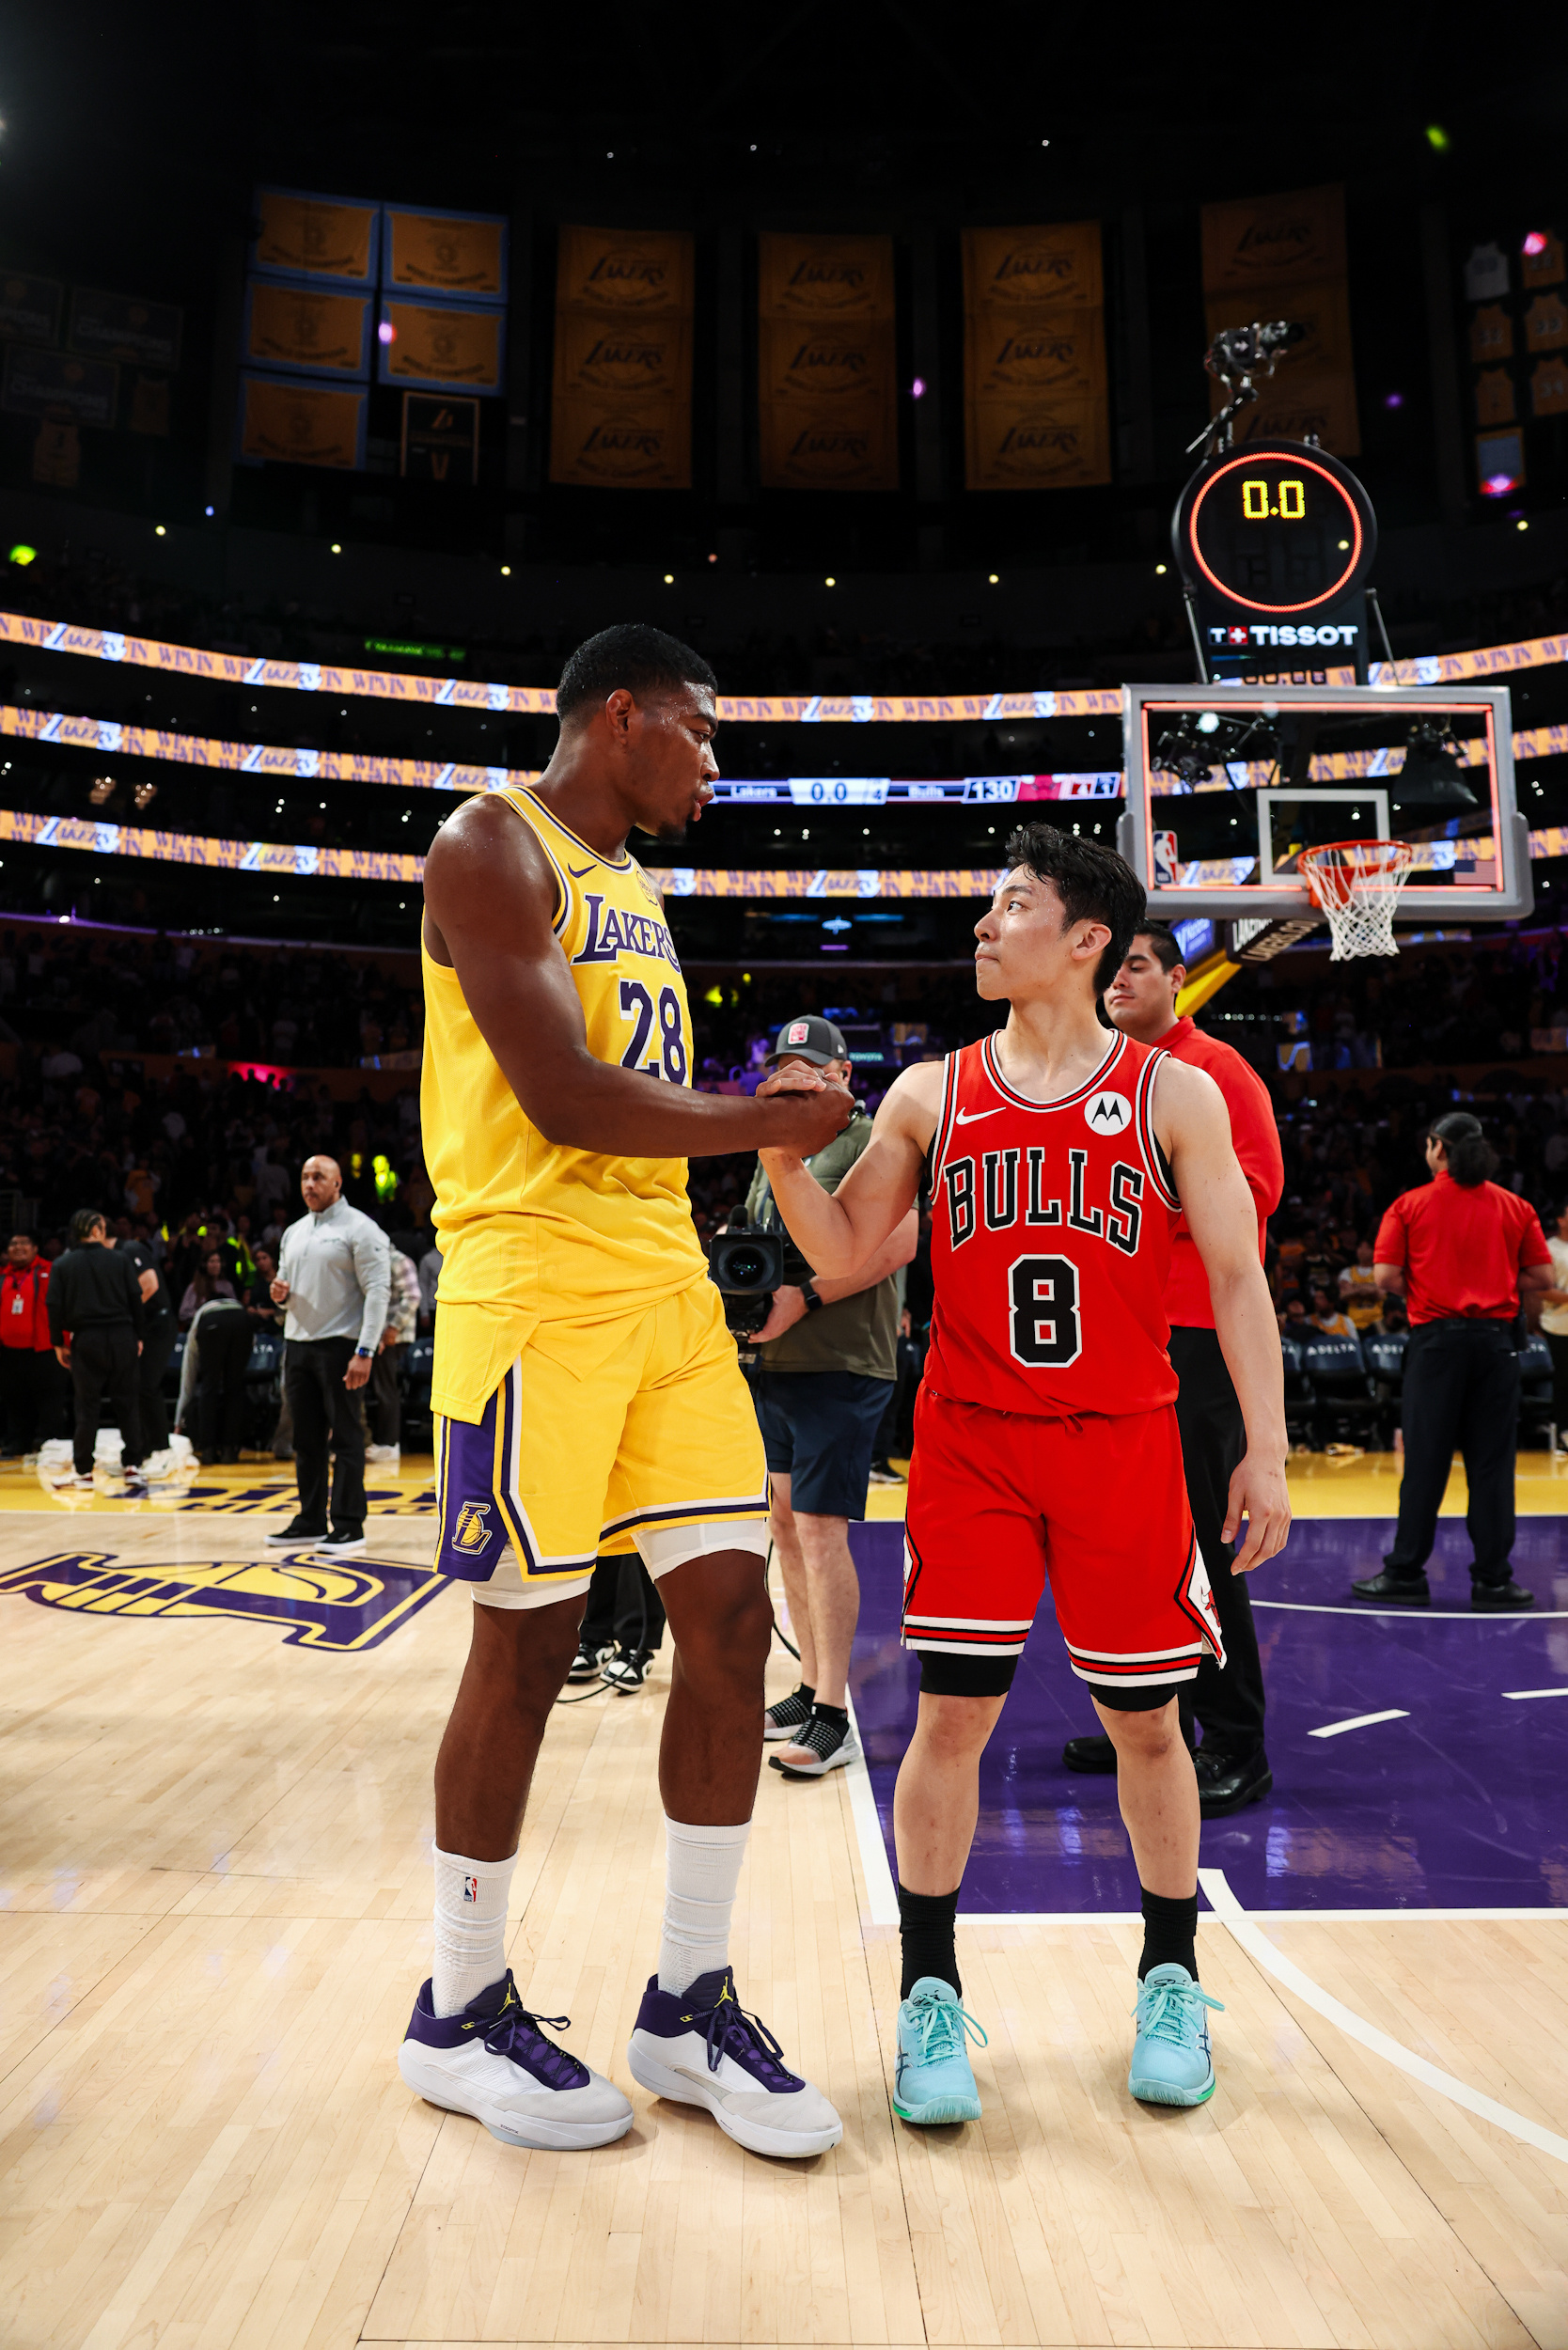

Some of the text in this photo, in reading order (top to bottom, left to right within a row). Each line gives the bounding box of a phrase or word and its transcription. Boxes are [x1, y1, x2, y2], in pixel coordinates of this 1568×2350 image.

[1242, 480, 1306, 519] 0.0
[1249, 625, 1358, 646] TISSOT
[811, 783, 847, 801] 0.0
[973, 781, 1014, 801] 130
[570, 893, 682, 975] LAKERS
[619, 977, 688, 1089] 28
[943, 1147, 1145, 1258] BULLS
[1008, 1254, 1082, 1368] 8
[1318, 1342, 1356, 1355] DELTA
